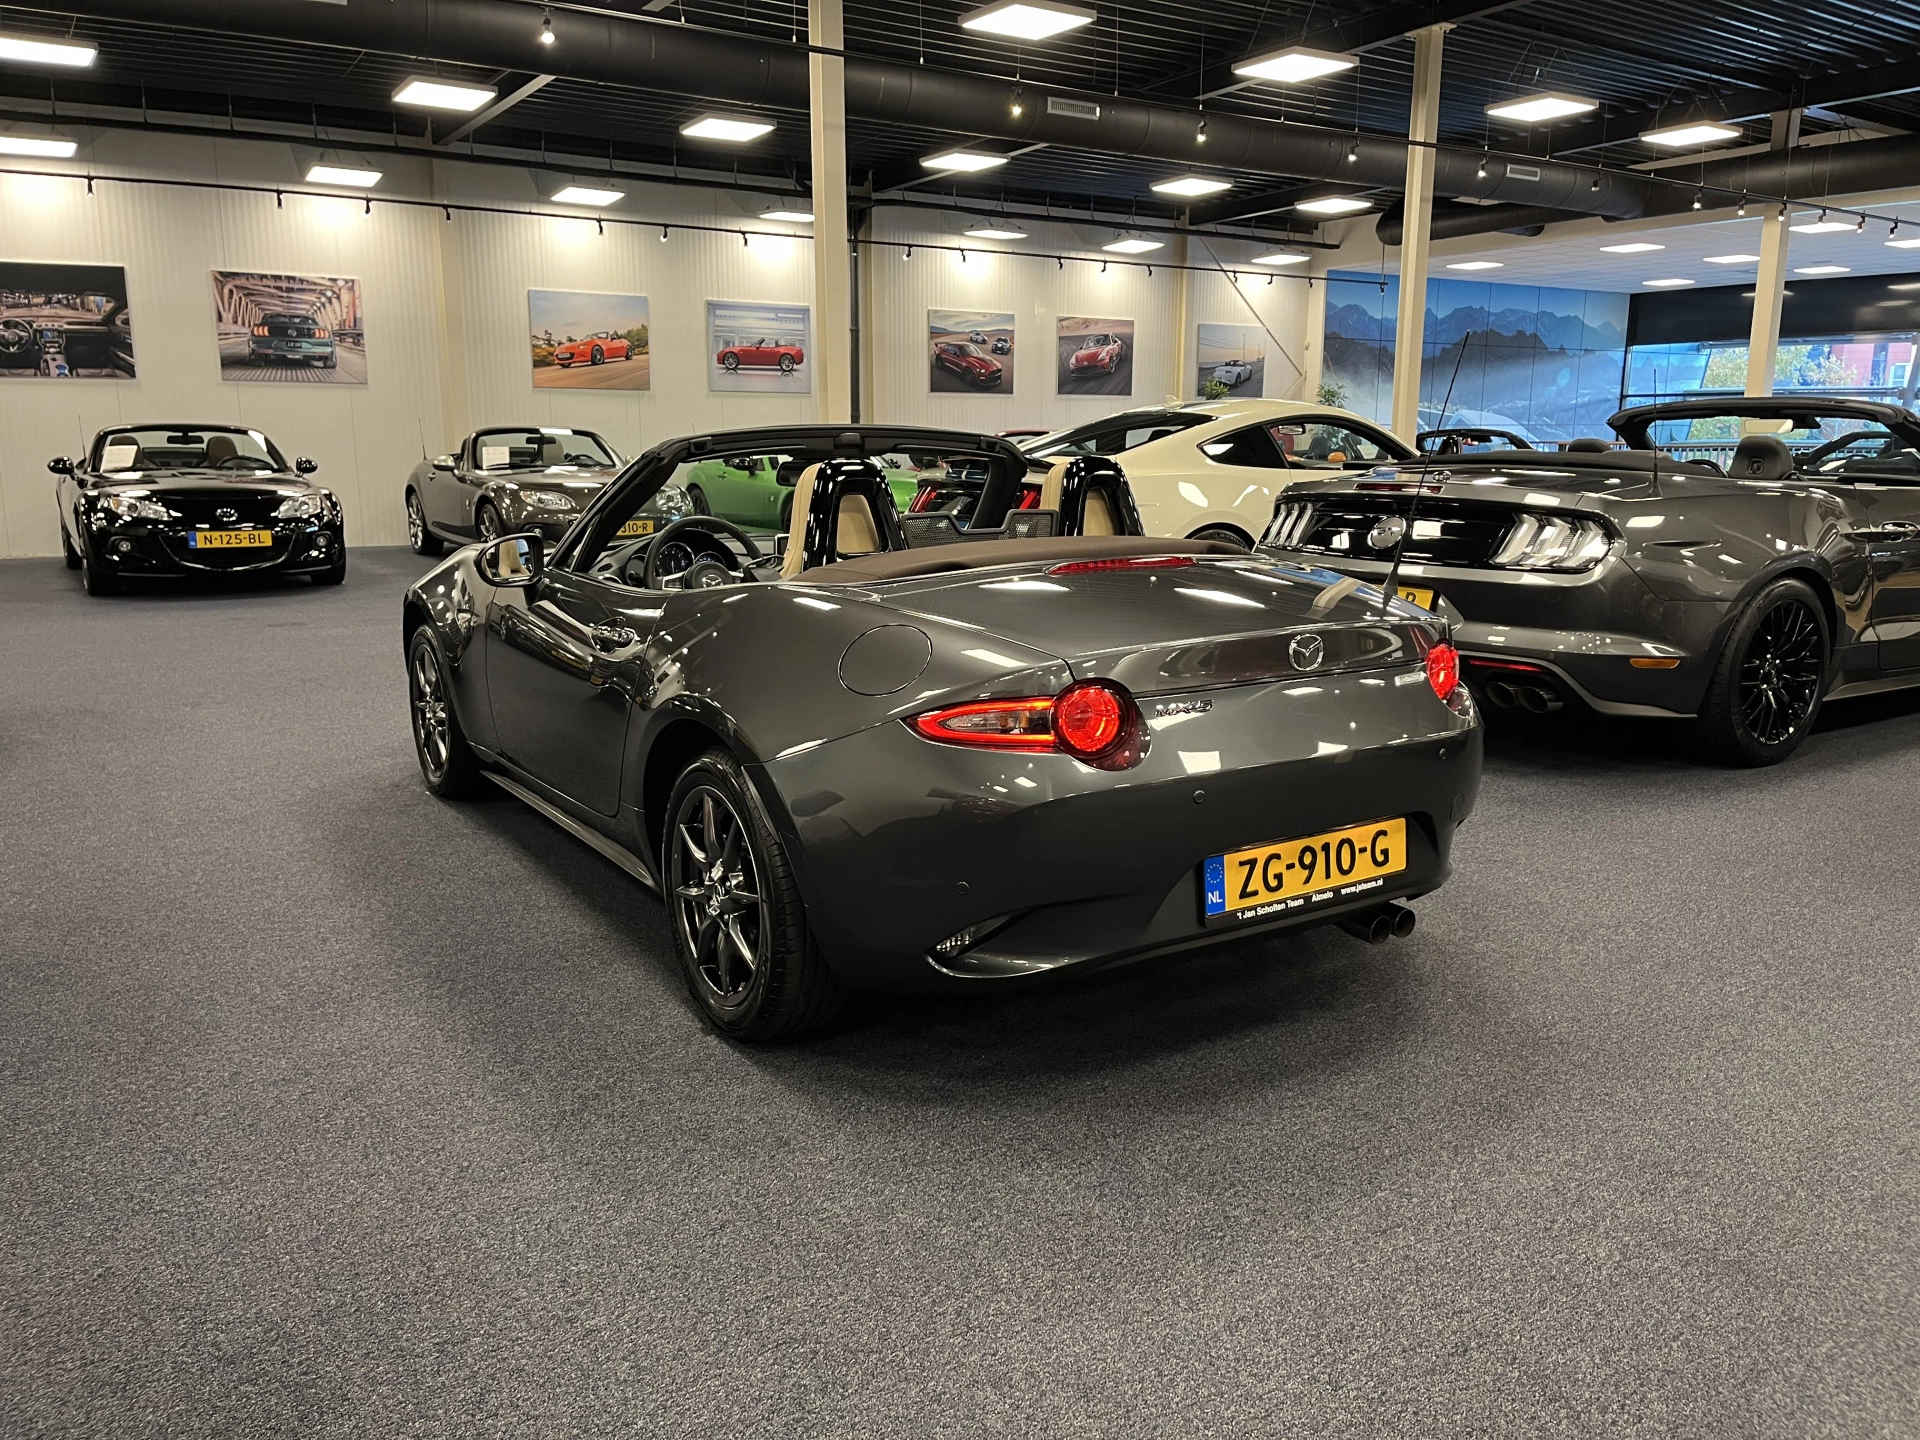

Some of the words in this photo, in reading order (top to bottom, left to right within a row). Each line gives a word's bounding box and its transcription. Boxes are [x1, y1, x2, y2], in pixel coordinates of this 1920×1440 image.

[203, 533, 266, 545] N-125-BL
[1238, 829, 1390, 900] ZG-910-G
[1208, 890, 1223, 904] NL
[1243, 908, 1256, 919] Jan
[1286, 898, 1305, 908] Team
[1311, 890, 1334, 902] Almelo
